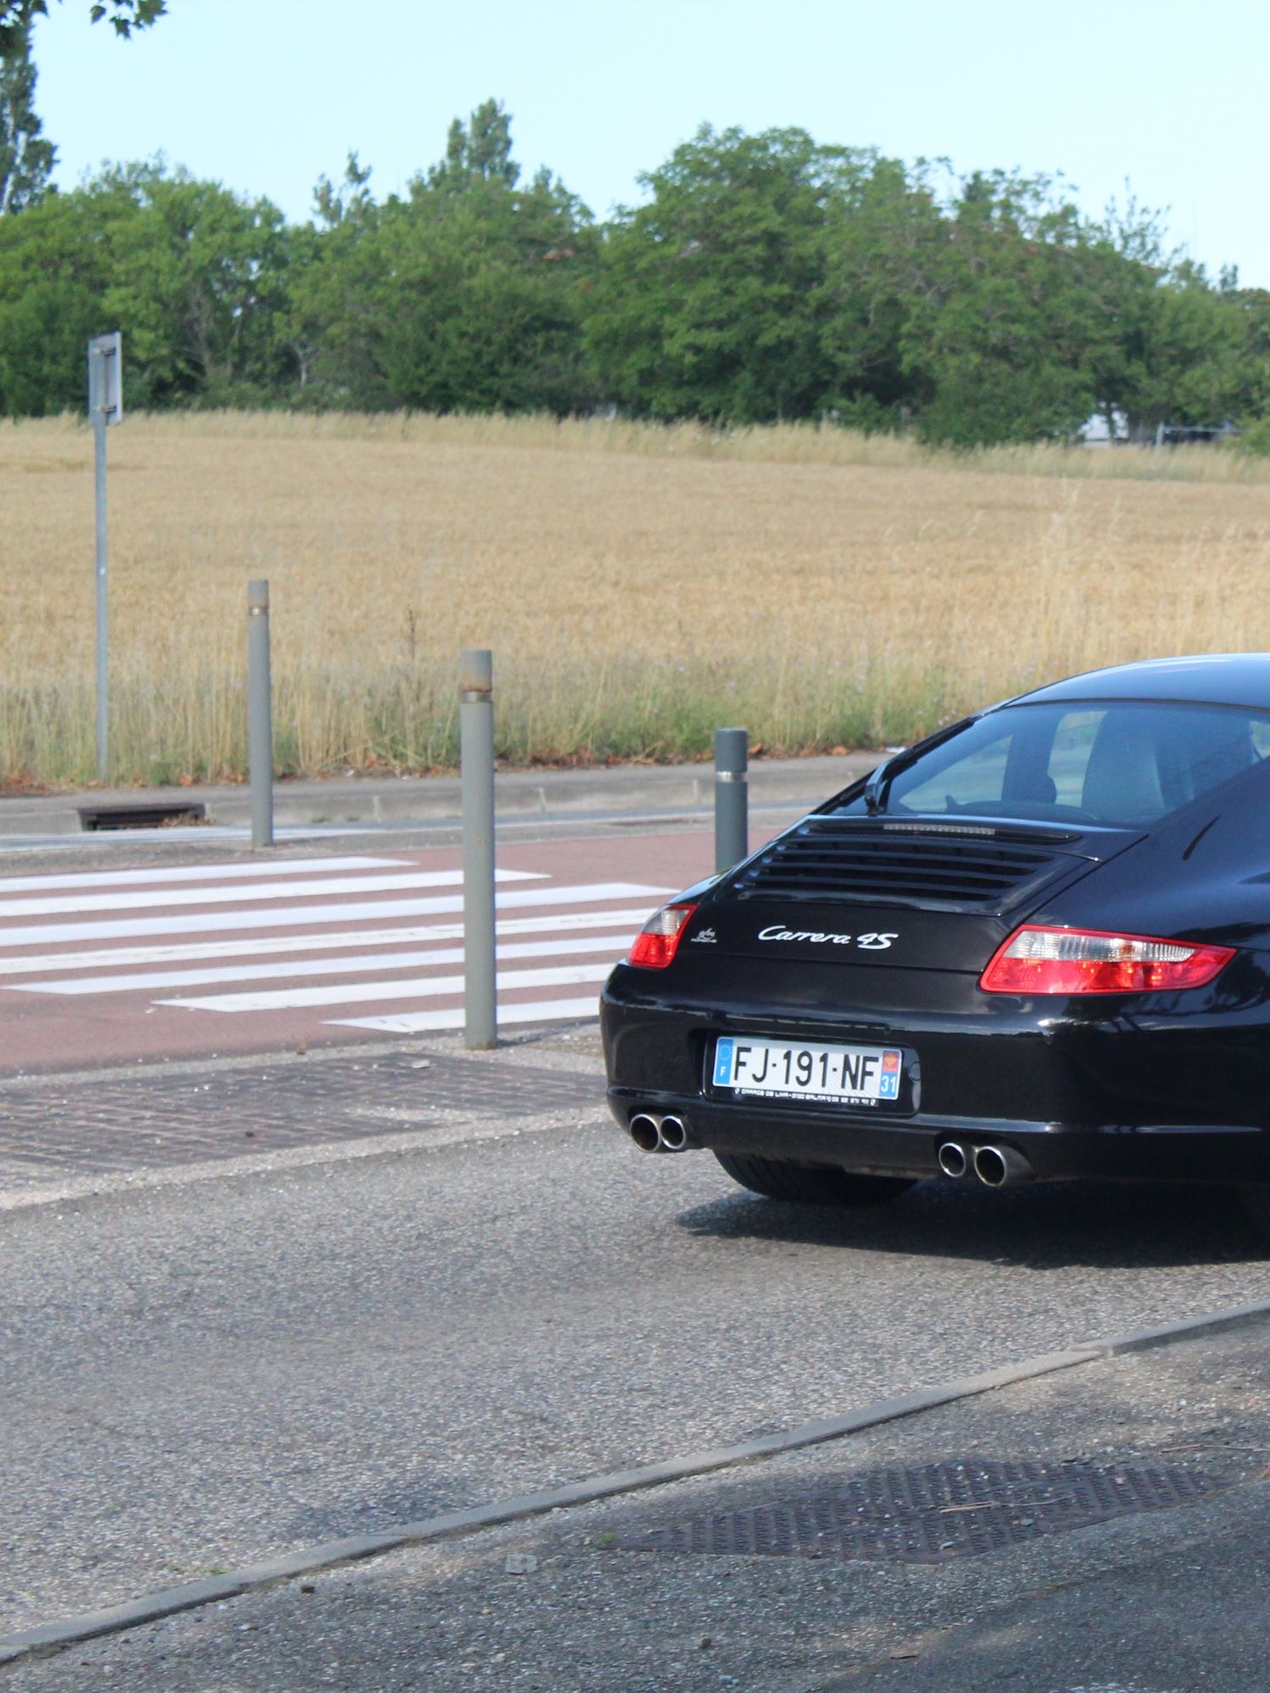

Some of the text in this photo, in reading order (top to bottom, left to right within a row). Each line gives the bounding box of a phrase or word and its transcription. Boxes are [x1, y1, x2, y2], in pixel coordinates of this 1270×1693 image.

[758, 925, 899, 950] Carrera 4S
[881, 1075, 897, 1093] 31
